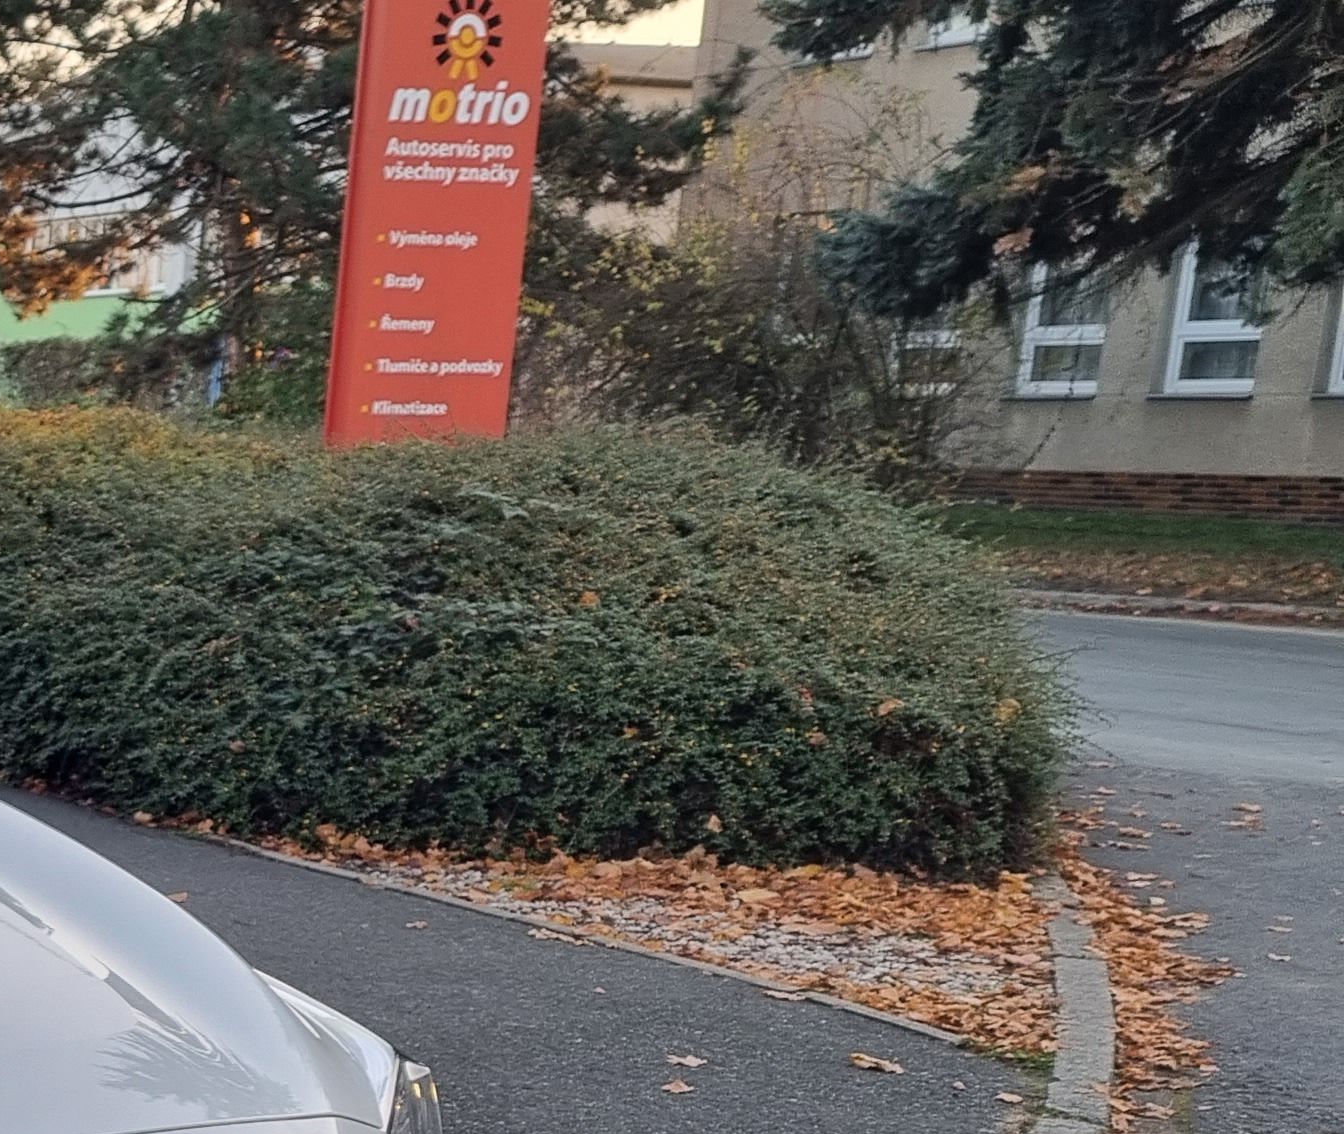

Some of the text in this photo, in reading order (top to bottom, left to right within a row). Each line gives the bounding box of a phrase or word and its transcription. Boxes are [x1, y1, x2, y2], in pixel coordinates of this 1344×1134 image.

[388, 80, 531, 126] motrio
[385, 136, 514, 163] Autoservis pro
[384, 161, 519, 187] všechny značky
[389, 230, 478, 250] Výměna oleje
[383, 273, 424, 292] Brzdy
[377, 358, 503, 377] Tlumiče a podvozky
[371, 400, 448, 415] Klimatizace
